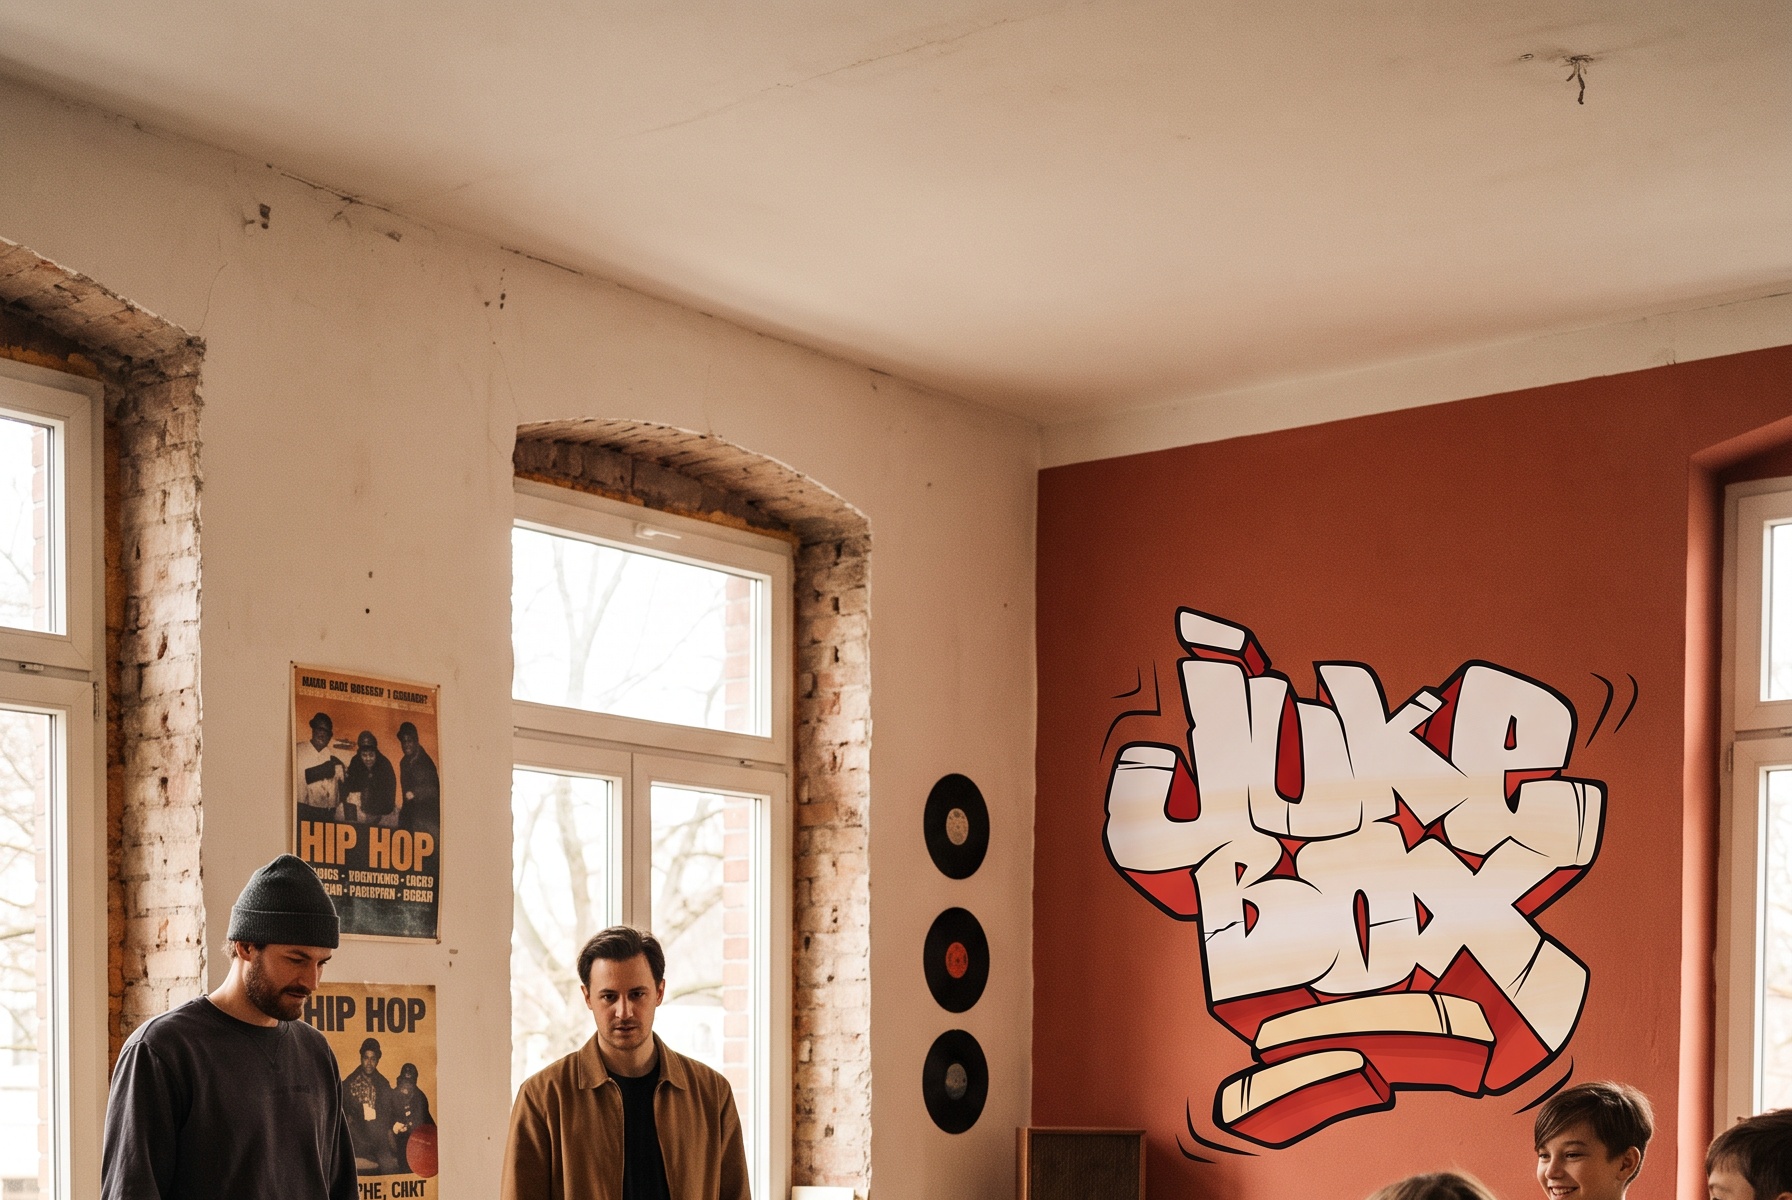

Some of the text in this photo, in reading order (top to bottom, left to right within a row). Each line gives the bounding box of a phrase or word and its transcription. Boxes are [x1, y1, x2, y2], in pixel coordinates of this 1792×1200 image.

[300, 820, 435, 872] HIP HOP
[1193, 840, 1590, 1090] BOX
[303, 995, 427, 1034] HIP HOP
